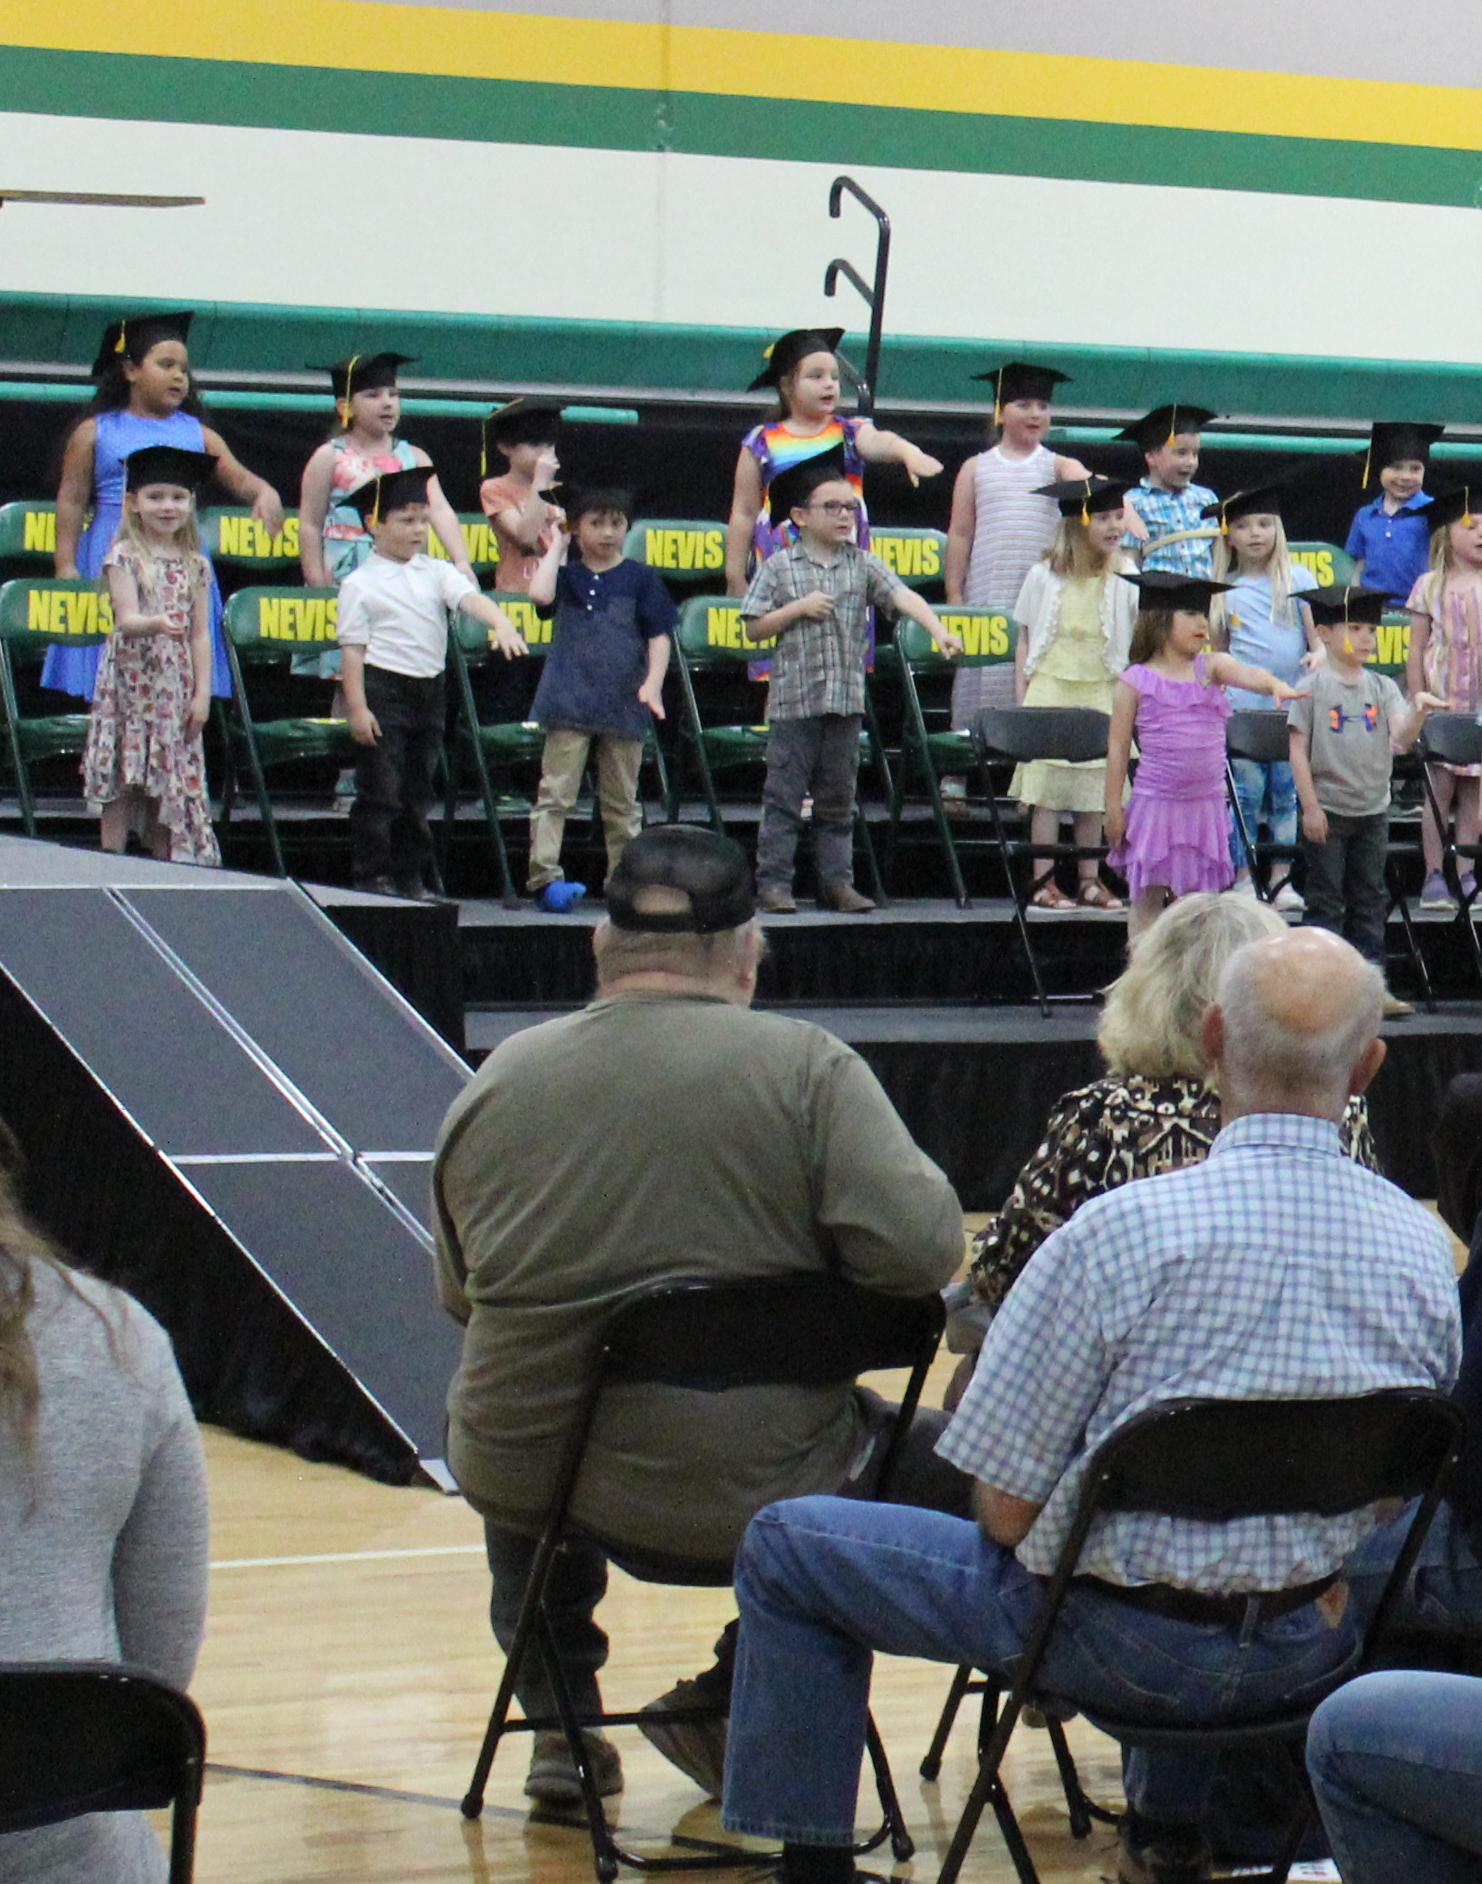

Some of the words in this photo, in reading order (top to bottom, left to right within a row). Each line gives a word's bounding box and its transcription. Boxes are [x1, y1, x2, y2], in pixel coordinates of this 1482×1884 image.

[645, 529, 724, 570] NEVIS
[28, 589, 115, 635] NEVIS
[487, 602, 553, 643] EVI
